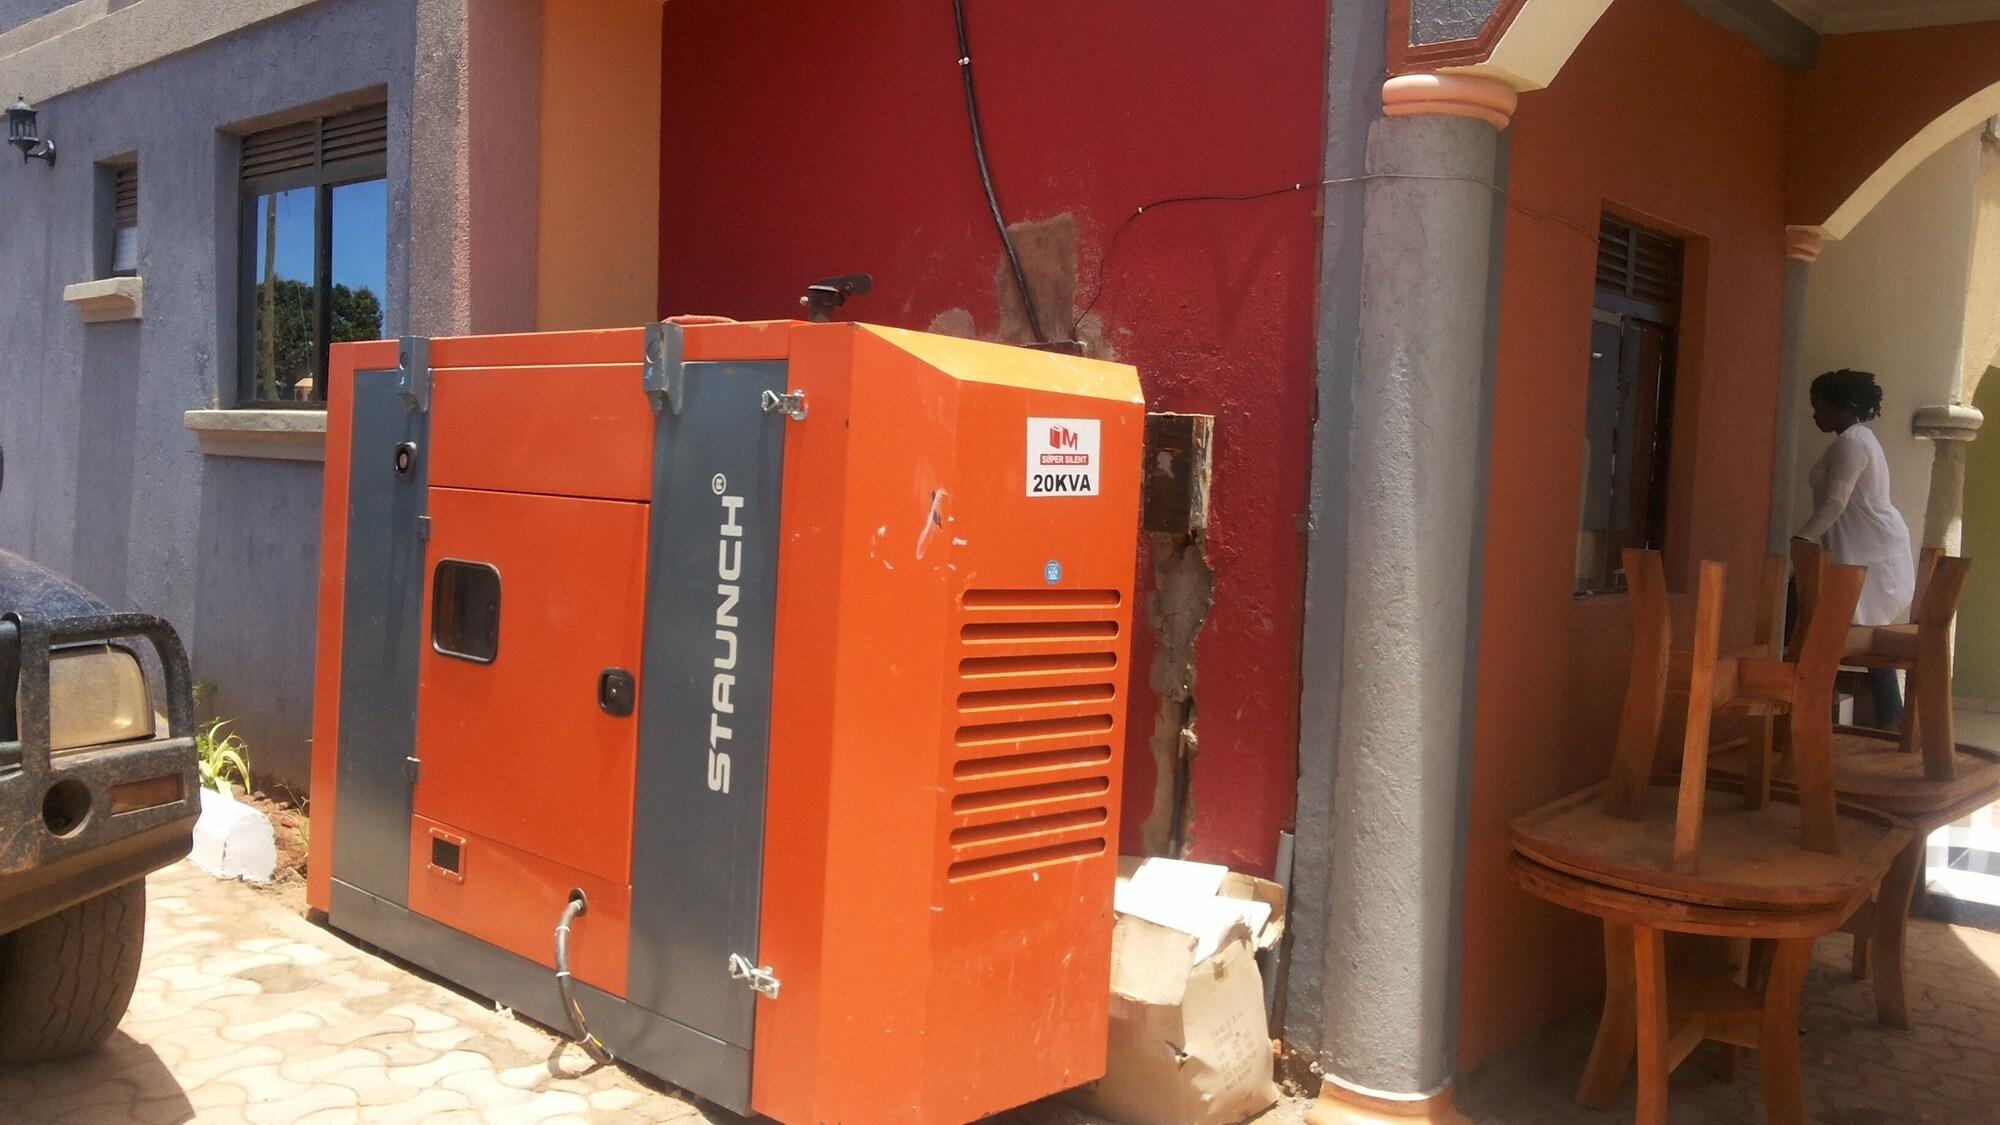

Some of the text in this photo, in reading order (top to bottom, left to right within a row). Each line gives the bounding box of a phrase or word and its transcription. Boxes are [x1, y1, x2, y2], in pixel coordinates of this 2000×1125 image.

[1041, 455, 1088, 464] SUPER SILENT
[1033, 475, 1091, 492] 20KVA
